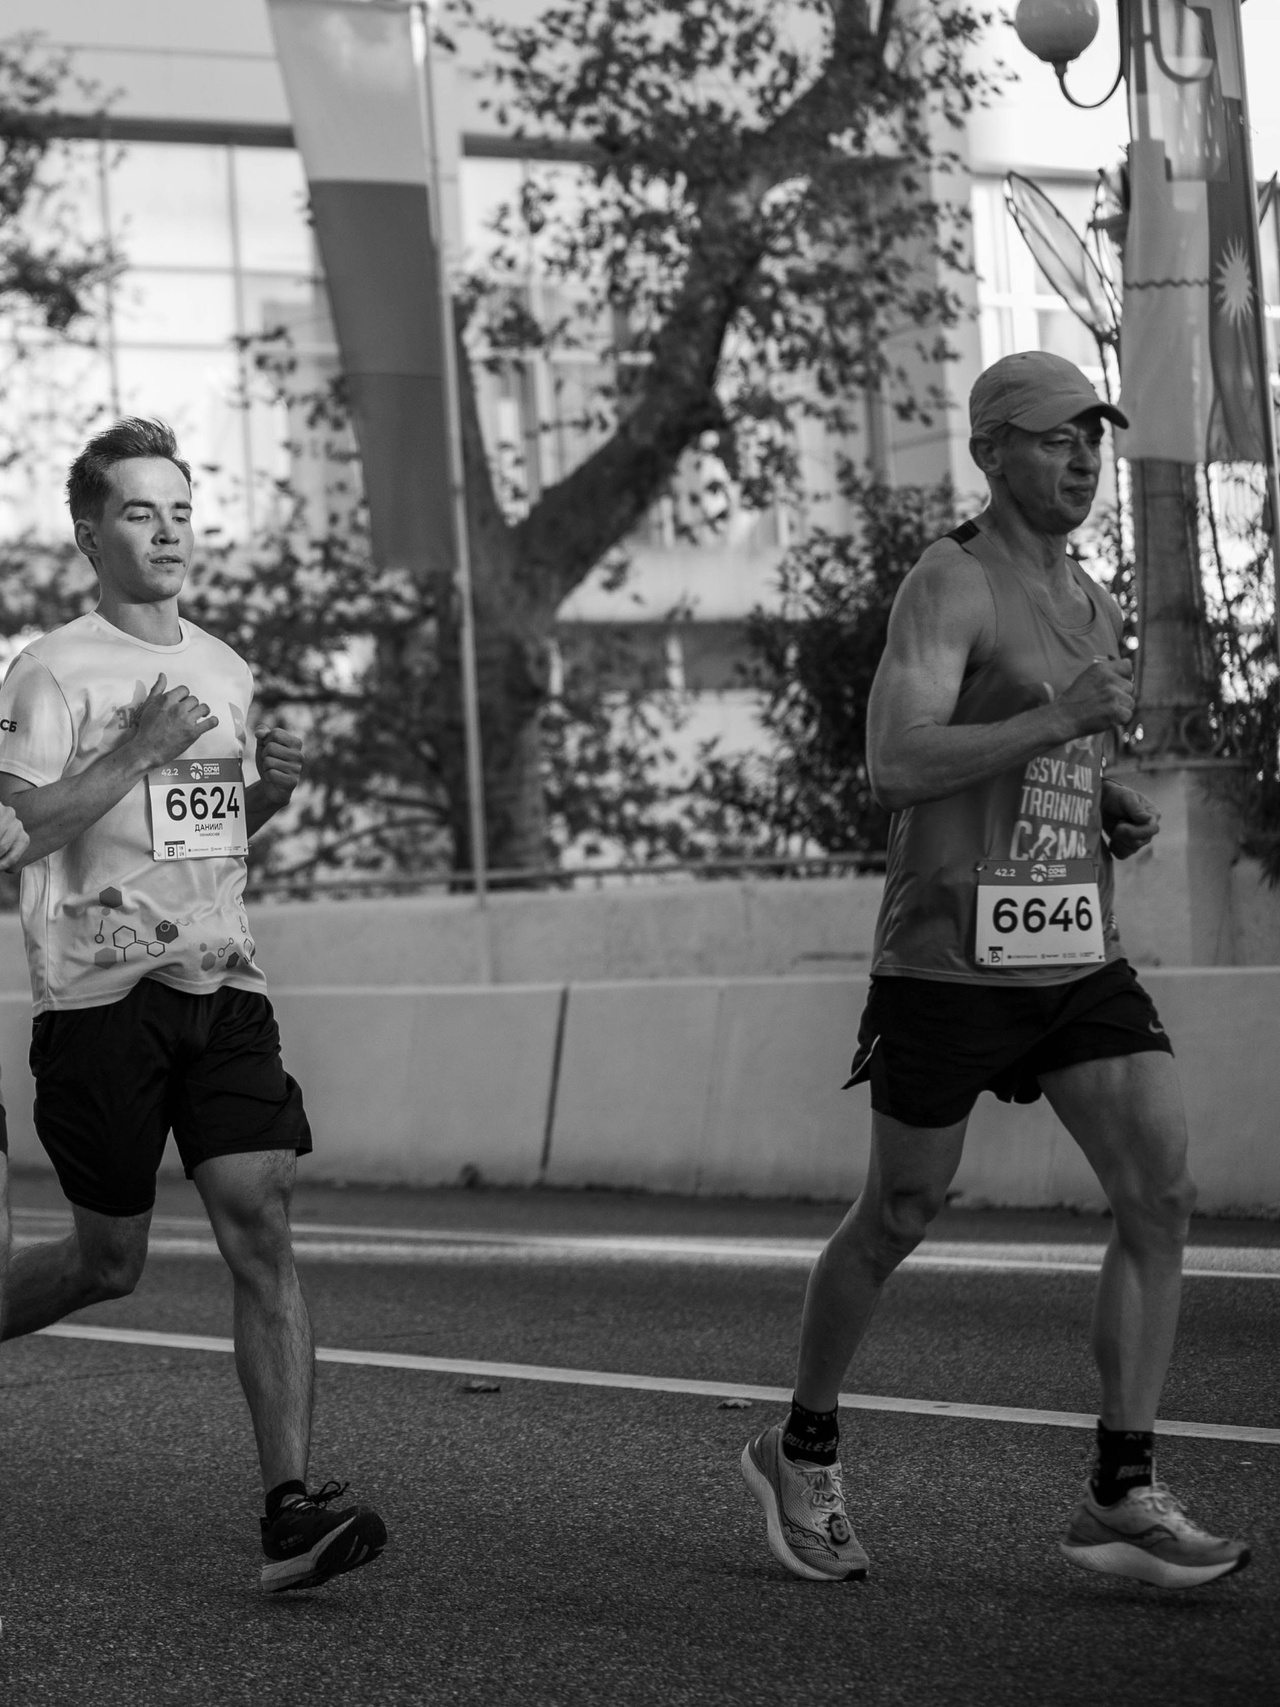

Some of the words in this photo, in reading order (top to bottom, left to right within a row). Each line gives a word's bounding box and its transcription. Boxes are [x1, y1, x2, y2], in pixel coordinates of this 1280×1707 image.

[161, 767, 179, 776] 42.2
[166, 786, 240, 822] 6624
[194, 822, 224, 832] ДАНИИЛ
[167, 846, 175, 857] B
[994, 868, 1016, 877] 42.2
[992, 896, 1093, 933] 6646
[991, 951, 1001, 963] B
